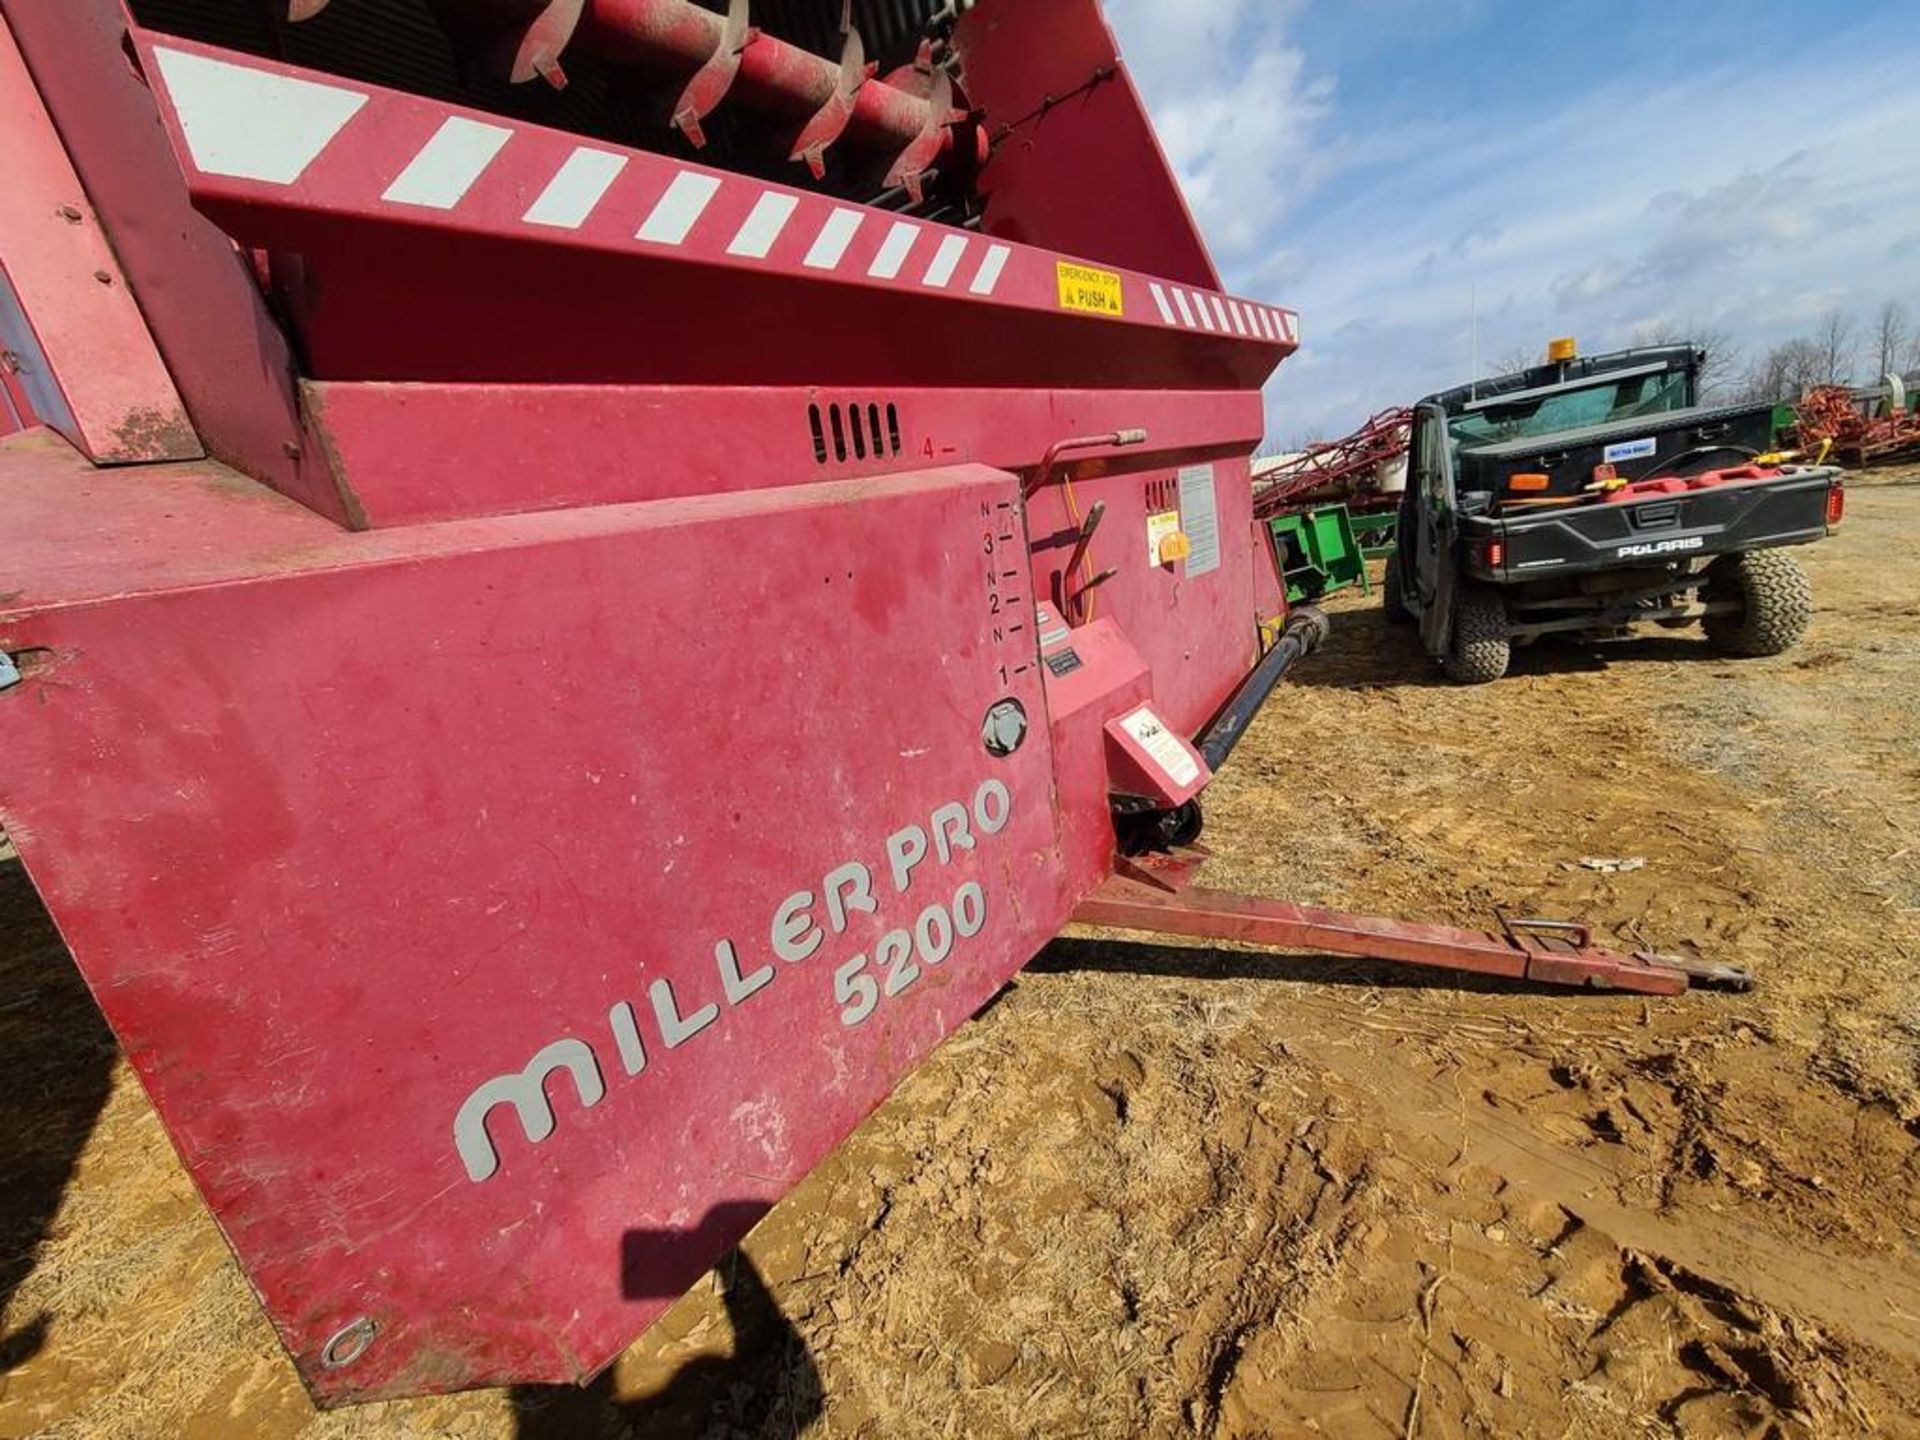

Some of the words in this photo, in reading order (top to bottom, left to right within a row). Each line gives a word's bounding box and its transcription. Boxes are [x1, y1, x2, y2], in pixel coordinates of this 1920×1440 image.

[1078, 288, 1106, 309] PUSH
[923, 437, 934, 459] 4
[984, 532, 994, 554] 3
[1617, 536, 1704, 558] POLARIS
[989, 593, 1000, 615] 2
[999, 665, 1008, 685] 1
[834, 881, 987, 1027] 5200
